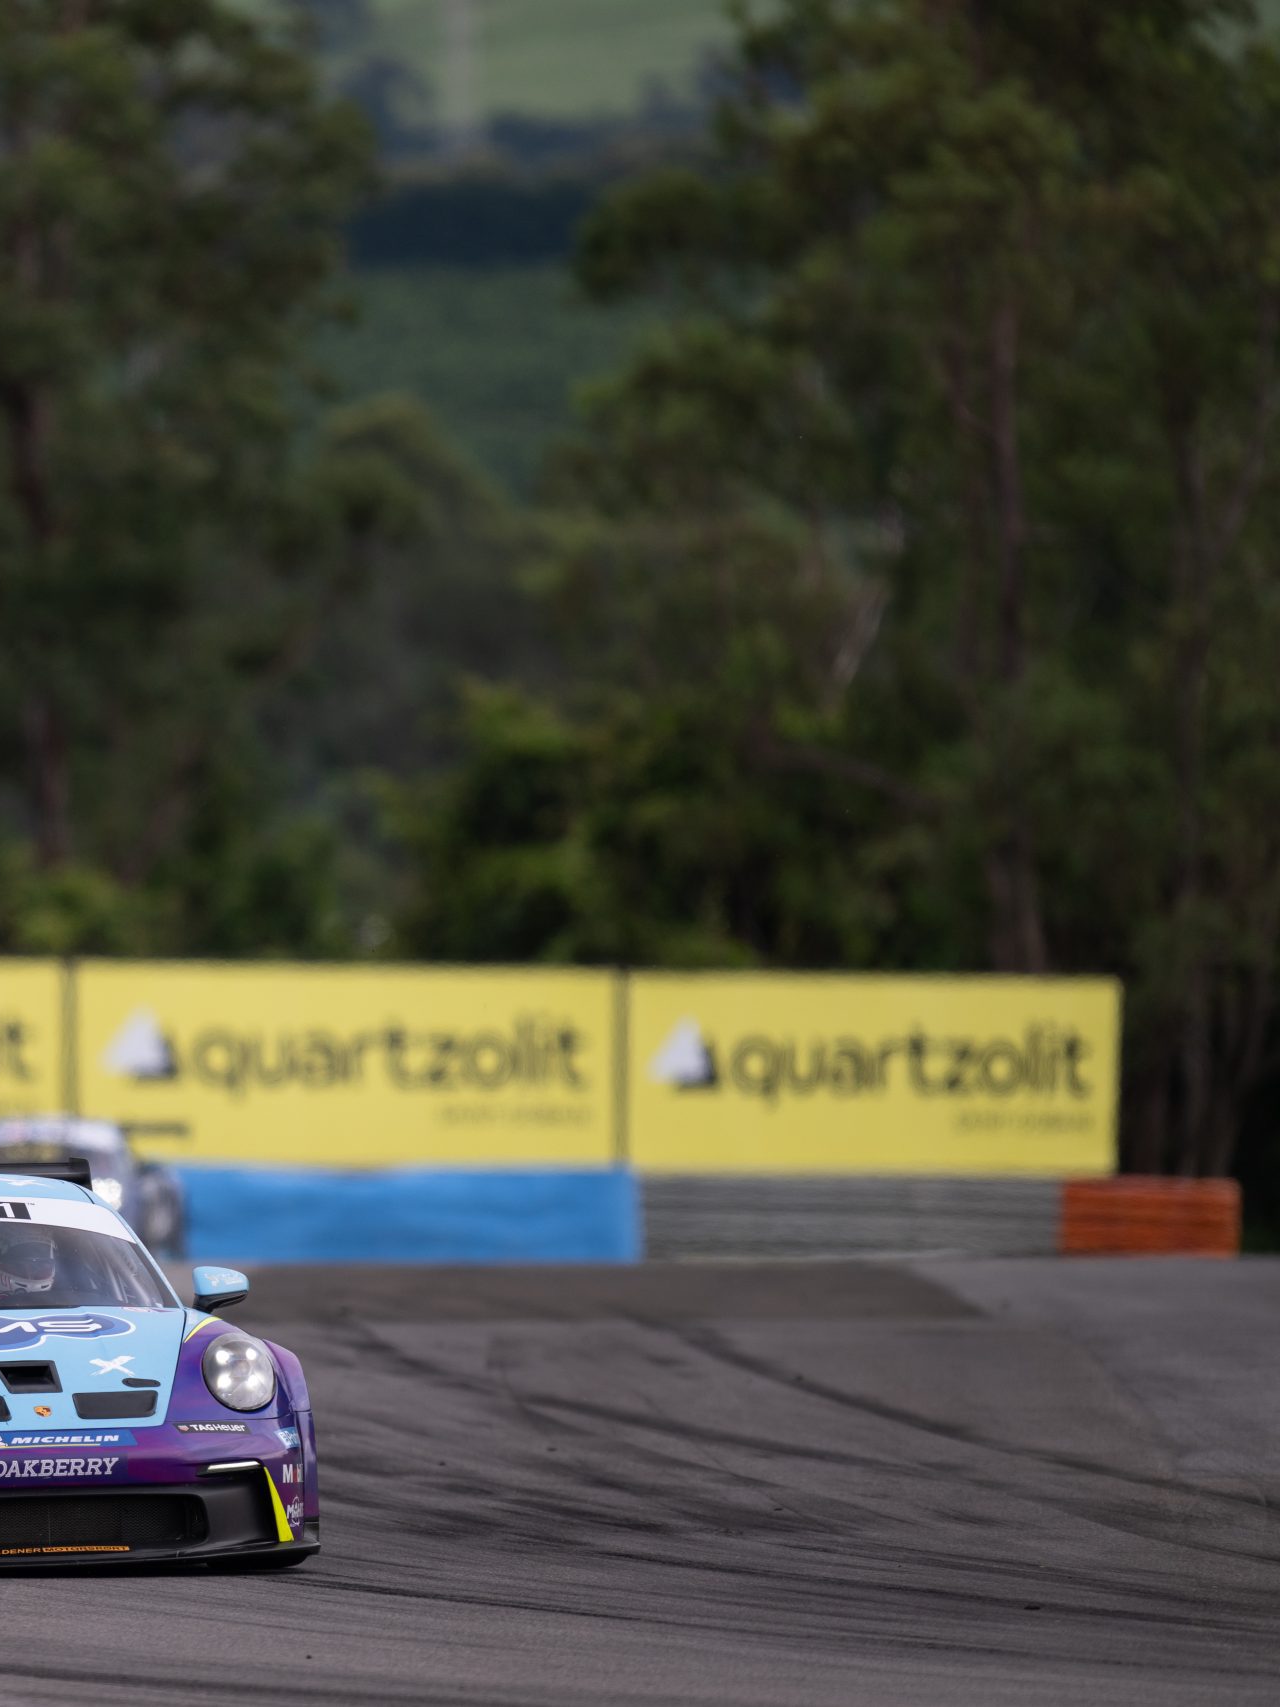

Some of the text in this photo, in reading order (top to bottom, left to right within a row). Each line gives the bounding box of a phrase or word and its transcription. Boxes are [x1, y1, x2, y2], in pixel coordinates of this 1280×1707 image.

[195, 1011, 586, 1102] quartzolit
[731, 1022, 1089, 1111] quartzolit
[10, 1434, 120, 1445] MICHELIN
[1, 1547, 42, 1555] DENER
